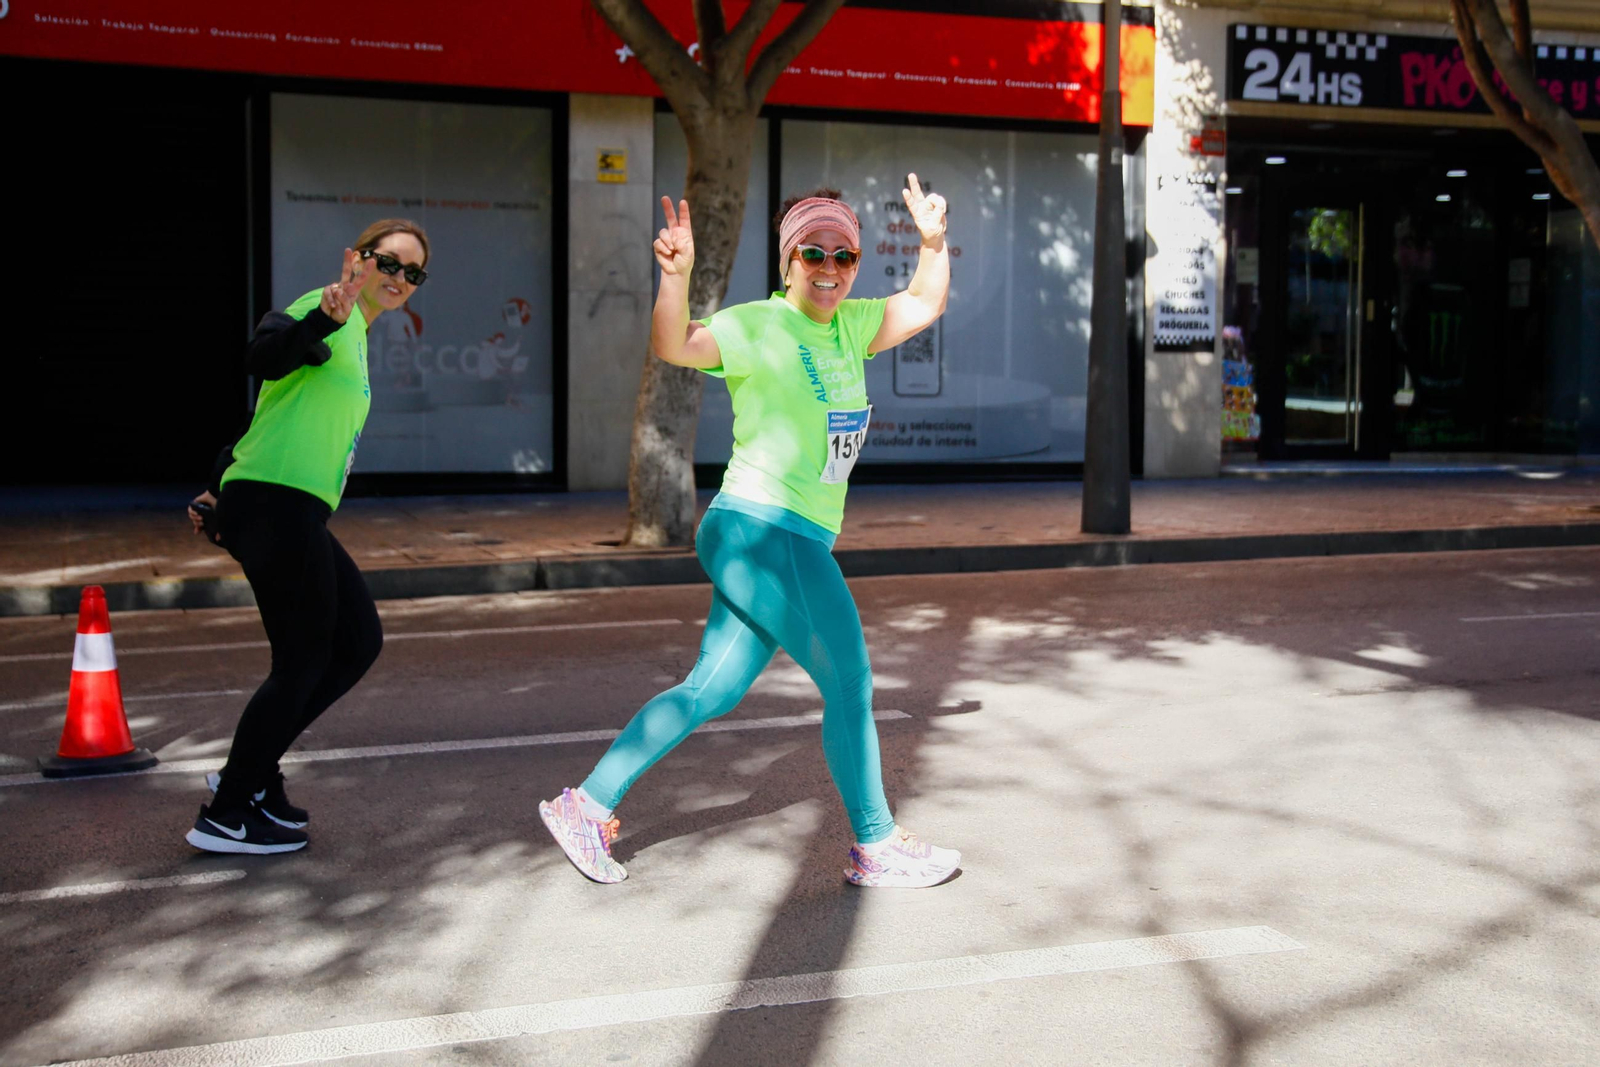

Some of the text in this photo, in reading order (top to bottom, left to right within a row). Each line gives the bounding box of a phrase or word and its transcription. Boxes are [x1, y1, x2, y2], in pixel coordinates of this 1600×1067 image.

[101, 19, 144, 31] Trabajo
[148, 22, 200, 35] Temporal
[210, 27, 277, 42] Outsourcing
[810, 67, 844, 78] Trabajo
[846, 69, 887, 80] Temporal
[893, 72, 947, 85] Outsourcing
[953, 75, 998, 87] Formación
[876, 240, 962, 258] de emo
[884, 262, 909, 277] a 1
[1160, 304, 1210, 315] RECARGAS
[898, 422, 906, 433] y
[910, 419, 972, 431] selecciona
[872, 435, 914, 447] ciudad
[916, 435, 931, 447] de
[935, 435, 977, 447] interés
